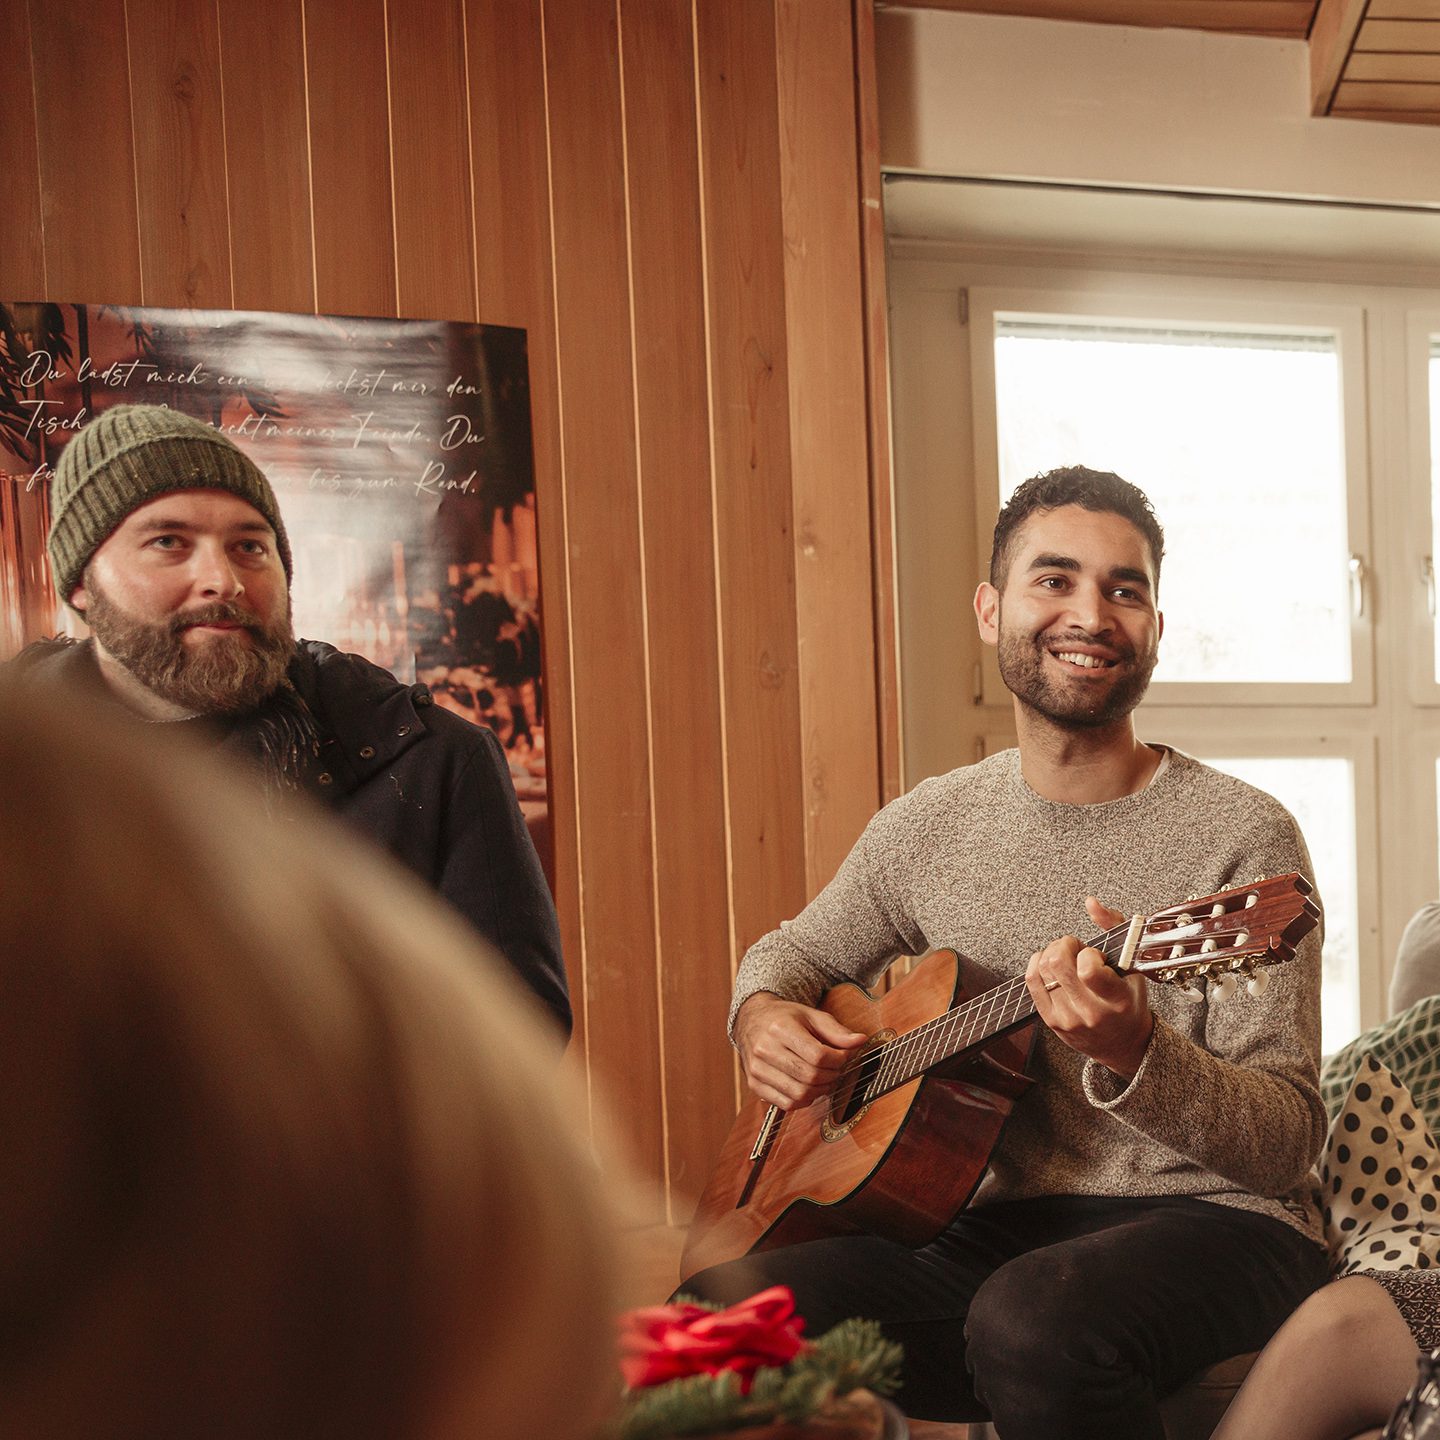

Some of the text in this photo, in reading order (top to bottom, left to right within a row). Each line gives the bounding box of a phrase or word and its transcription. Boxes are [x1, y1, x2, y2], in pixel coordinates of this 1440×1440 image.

[20, 350, 66, 388] Du
[77, 357, 158, 387] lädst
[146, 362, 208, 386] mich
[217, 374, 250, 387] ein
[391, 376, 436, 397] mir
[446, 375, 482, 398] den
[19, 400, 86, 440] Tisch
[265, 424, 337, 441] meiner
[440, 414, 484, 450] Du
[309, 468, 342, 491] bis
[414, 460, 477, 497] Rand.
